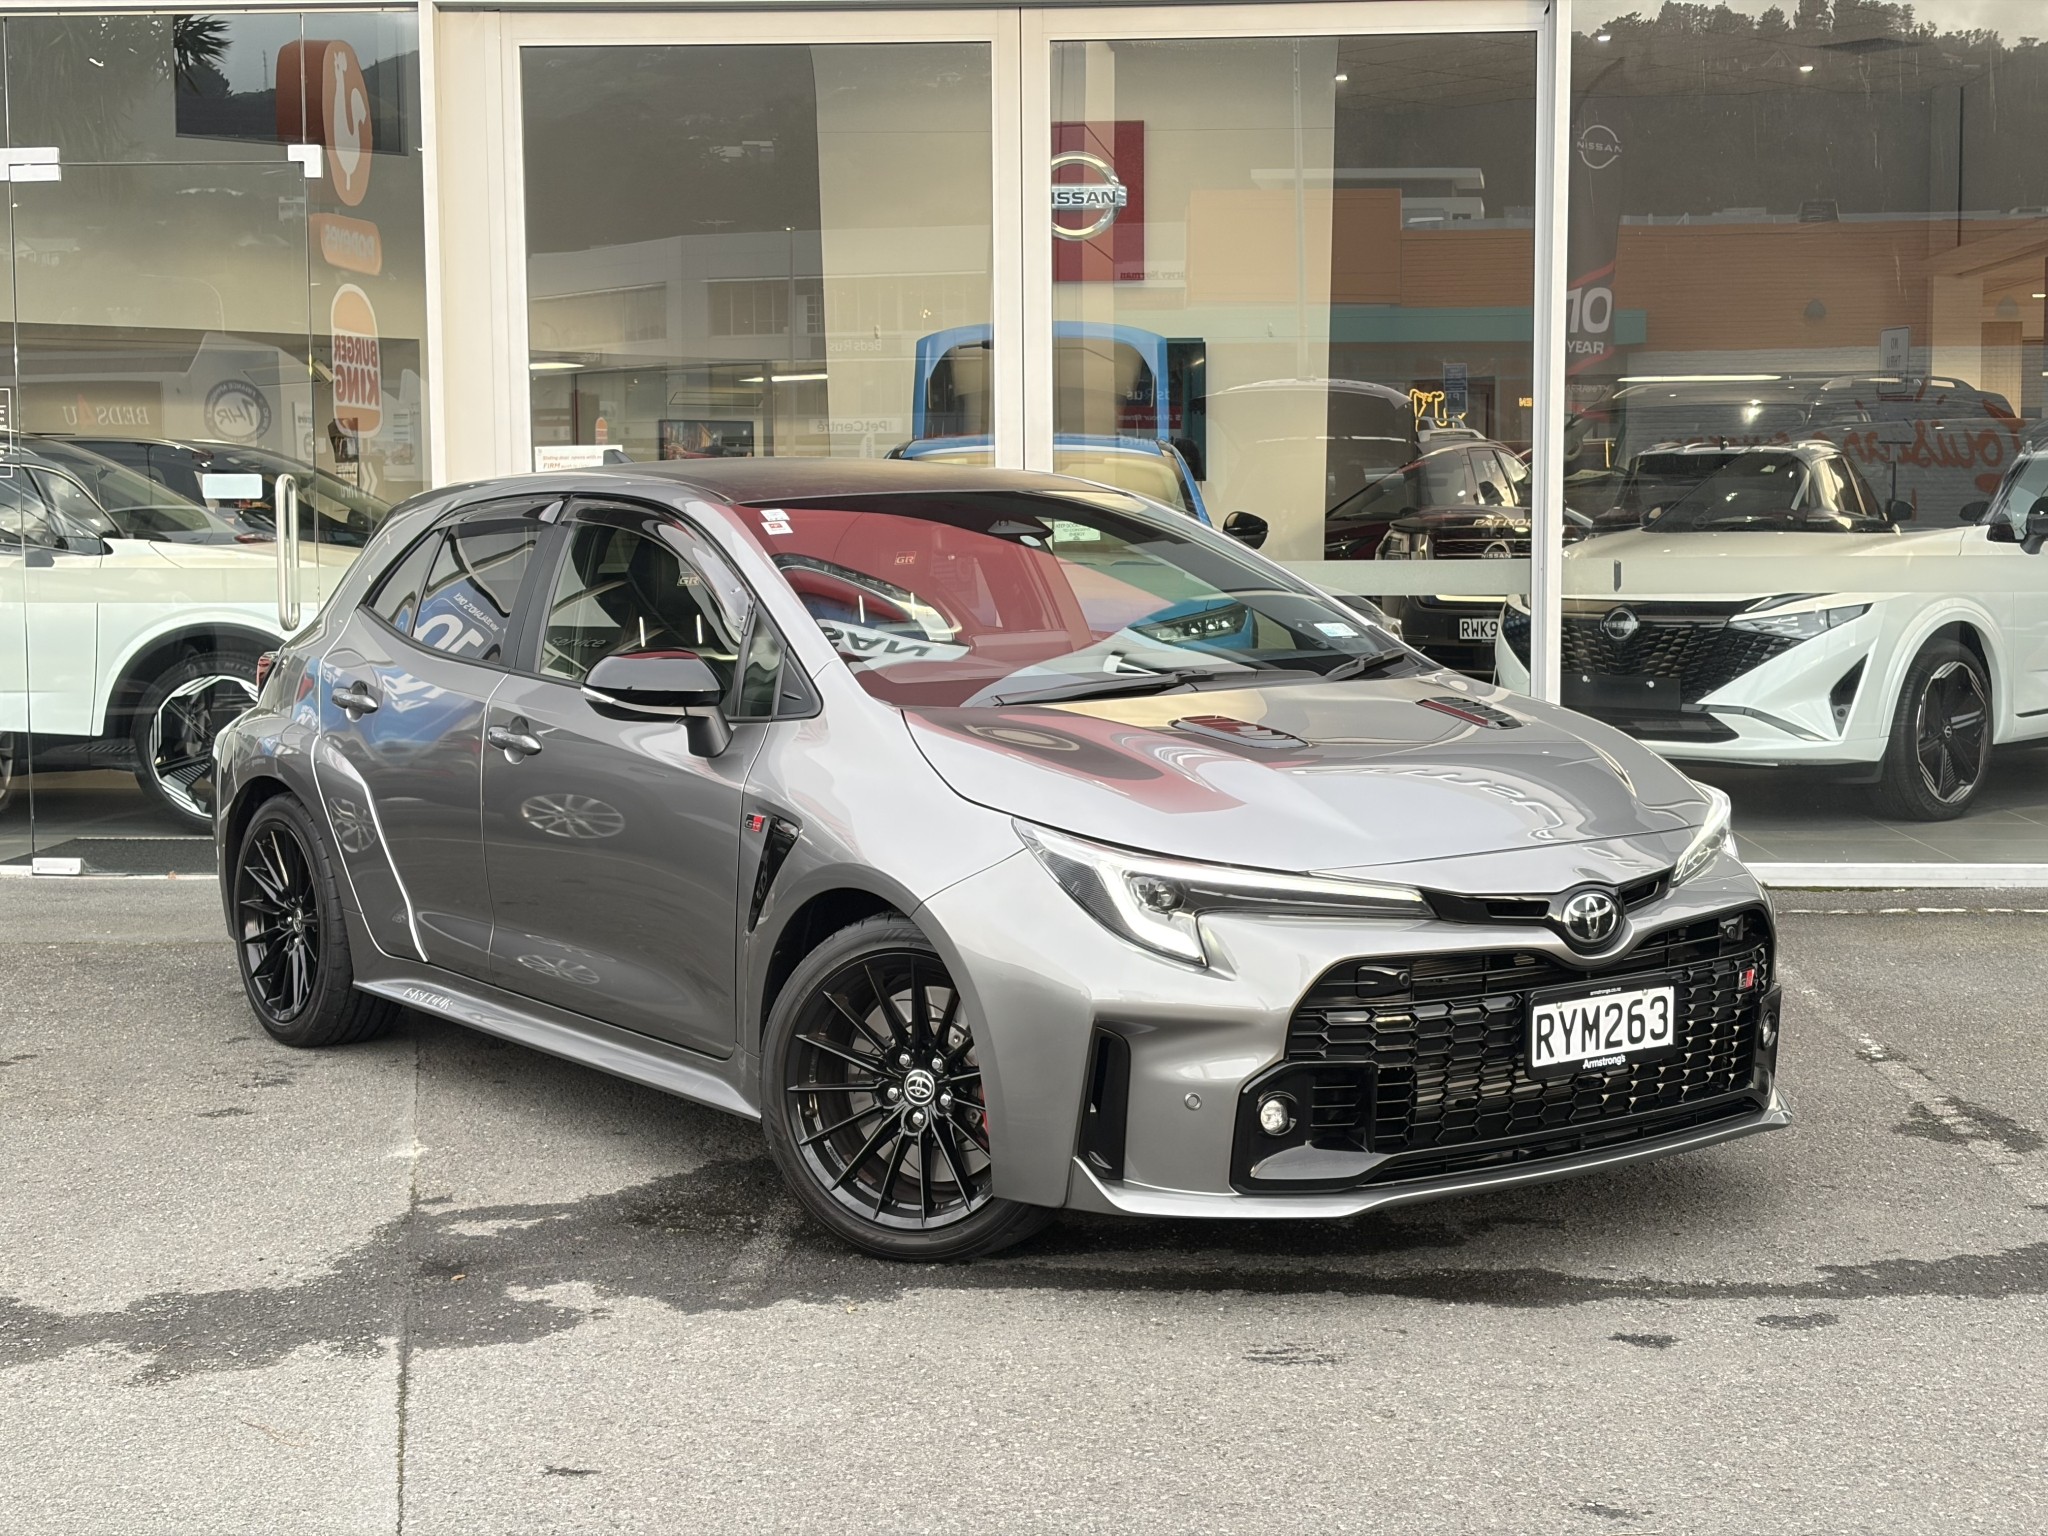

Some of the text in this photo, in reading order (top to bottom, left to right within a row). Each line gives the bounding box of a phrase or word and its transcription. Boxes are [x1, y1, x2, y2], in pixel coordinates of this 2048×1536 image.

[1577, 141, 1622, 152] NISSAN
[1052, 190, 1116, 204] ISSAN
[1567, 287, 1613, 333] 10
[1567, 341, 1604, 354] YEAR
[895, 555, 915, 564] GR
[679, 575, 700, 585] GR
[1461, 621, 1499, 638] RWK9
[551, 636, 607, 648] service
[744, 817, 765, 832] GR
[1536, 995, 1668, 1060] RYM263
[1582, 1053, 1626, 1070] Armstrong's
